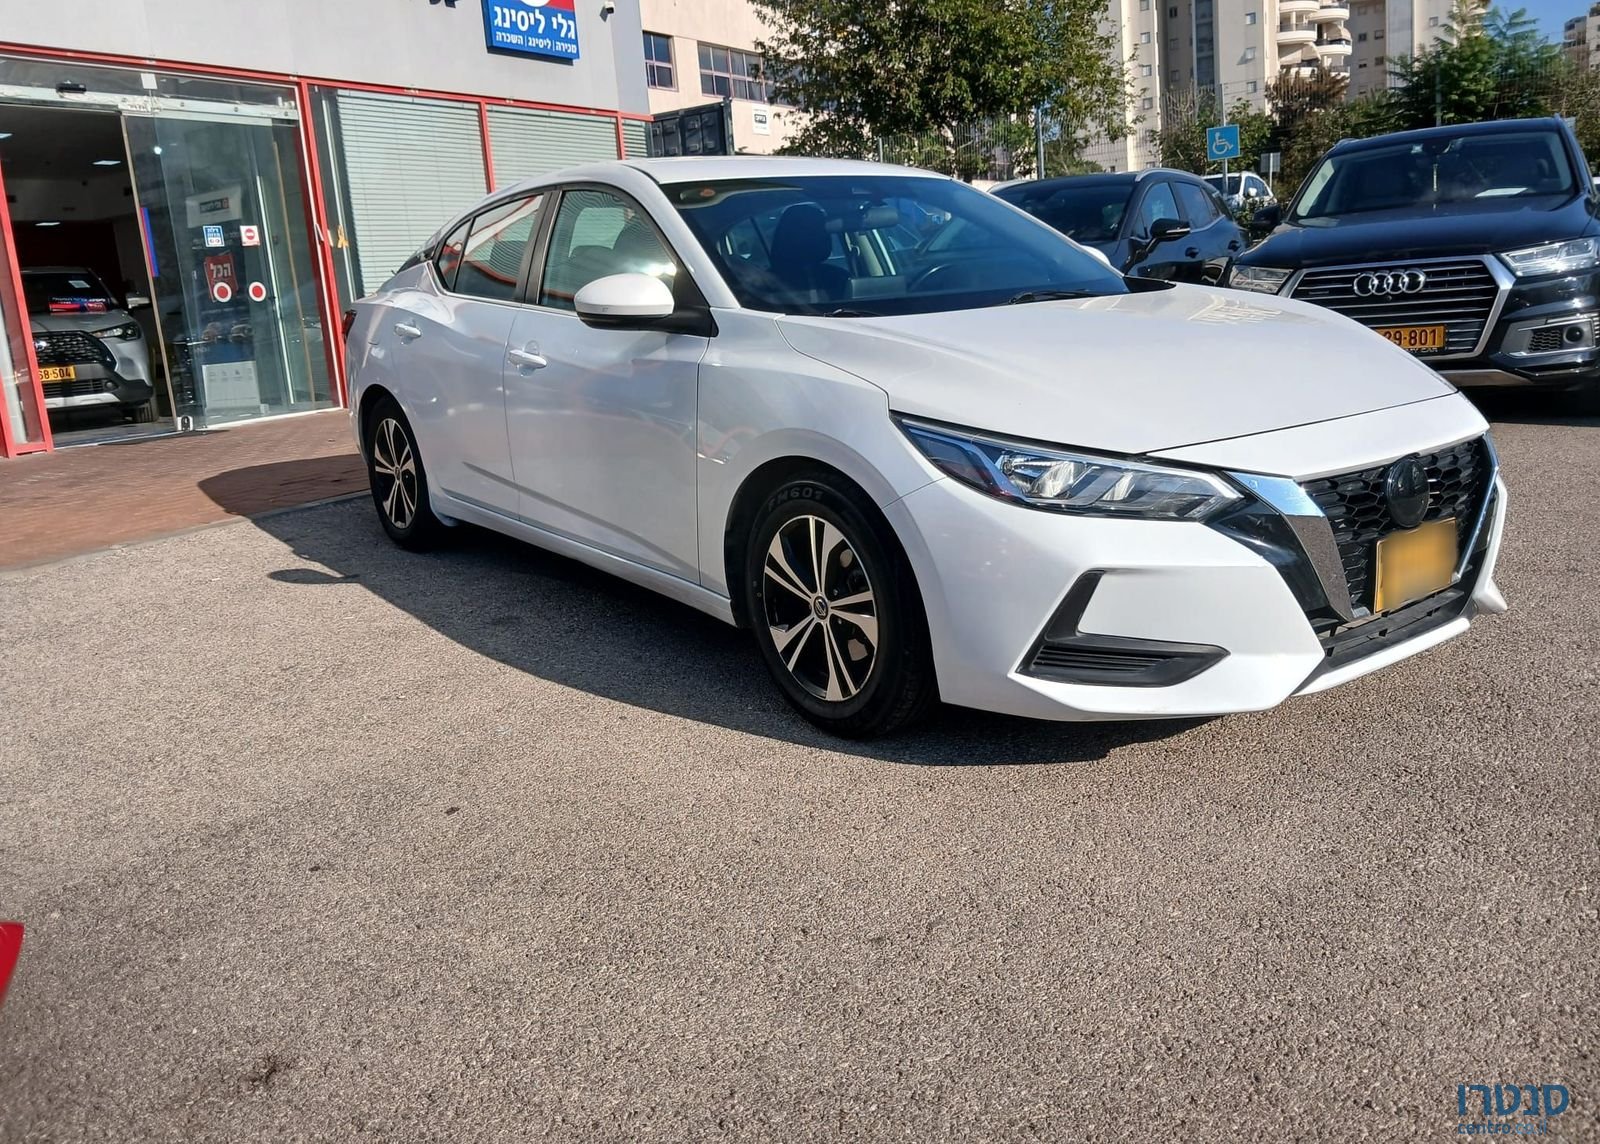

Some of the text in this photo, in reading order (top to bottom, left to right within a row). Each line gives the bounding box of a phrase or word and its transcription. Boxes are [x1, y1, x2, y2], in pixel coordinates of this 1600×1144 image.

[493, 6, 576, 39] גלי ליסינג
[495, 31, 524, 45] השכרה
